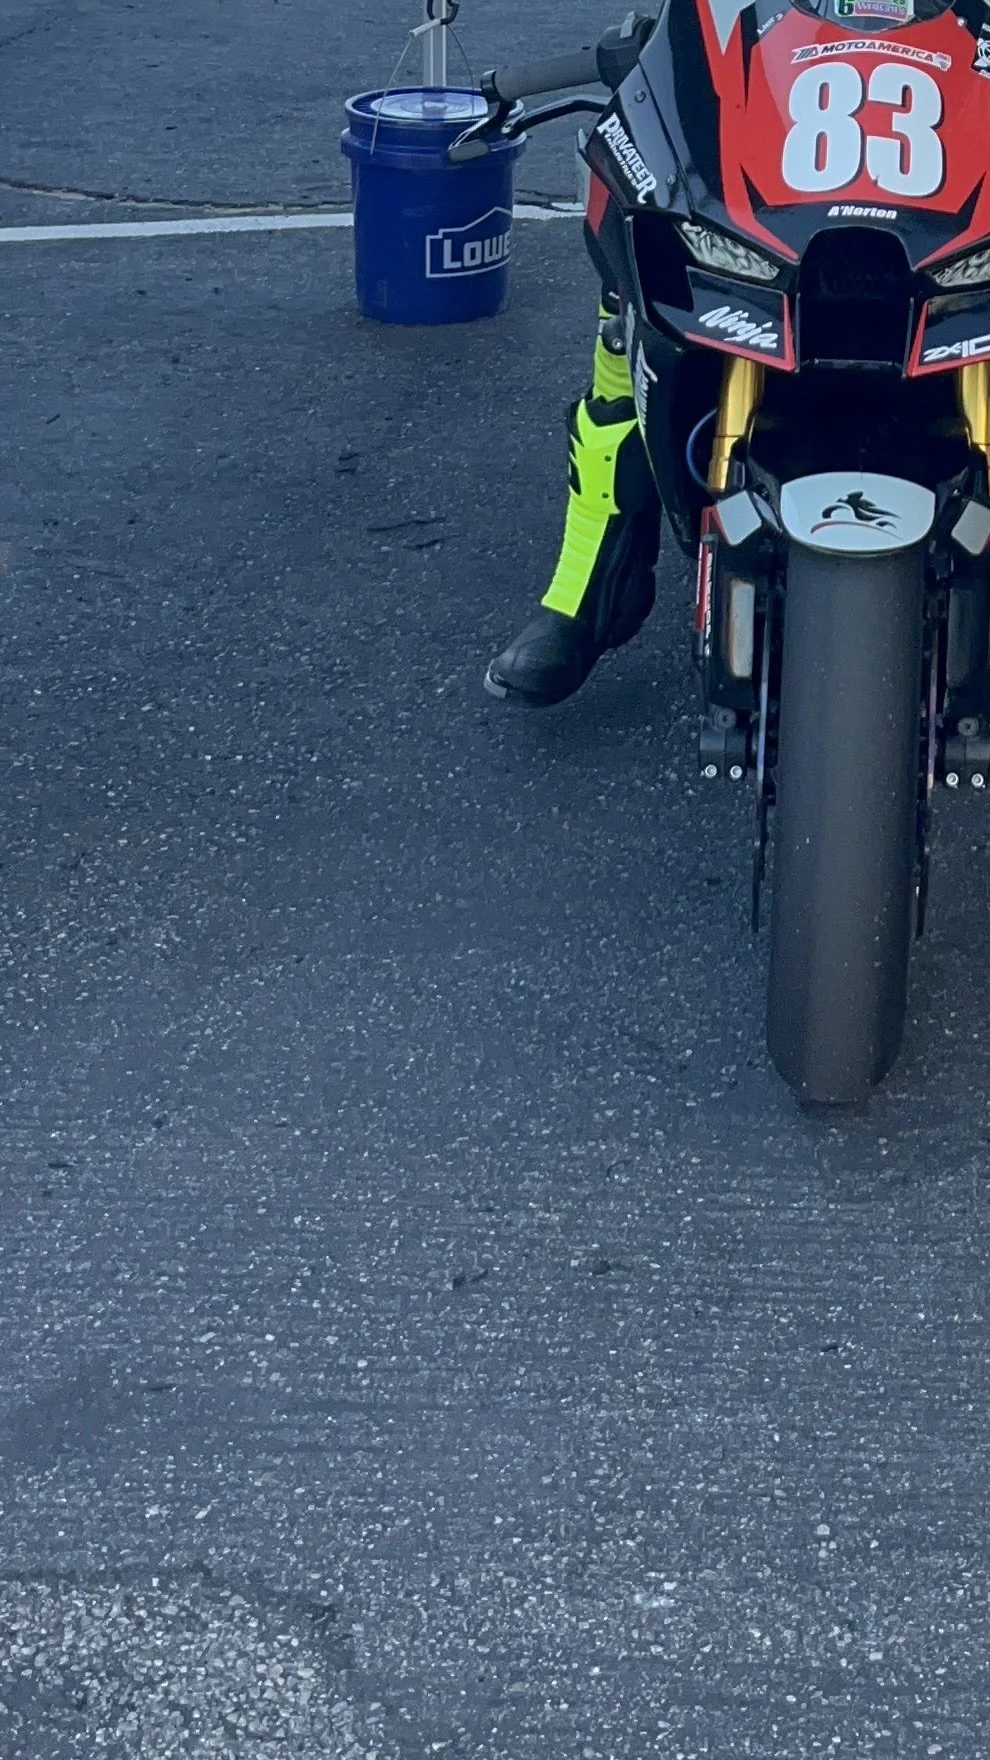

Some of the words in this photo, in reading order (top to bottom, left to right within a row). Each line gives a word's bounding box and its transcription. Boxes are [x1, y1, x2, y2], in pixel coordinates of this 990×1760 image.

[821, 40, 934, 63] MOTOAMERICA
[781, 61, 944, 197] 83
[596, 112, 657, 204] PRIVATEER
[443, 232, 511, 269] LOWE
[698, 305, 779, 349] Ninja
